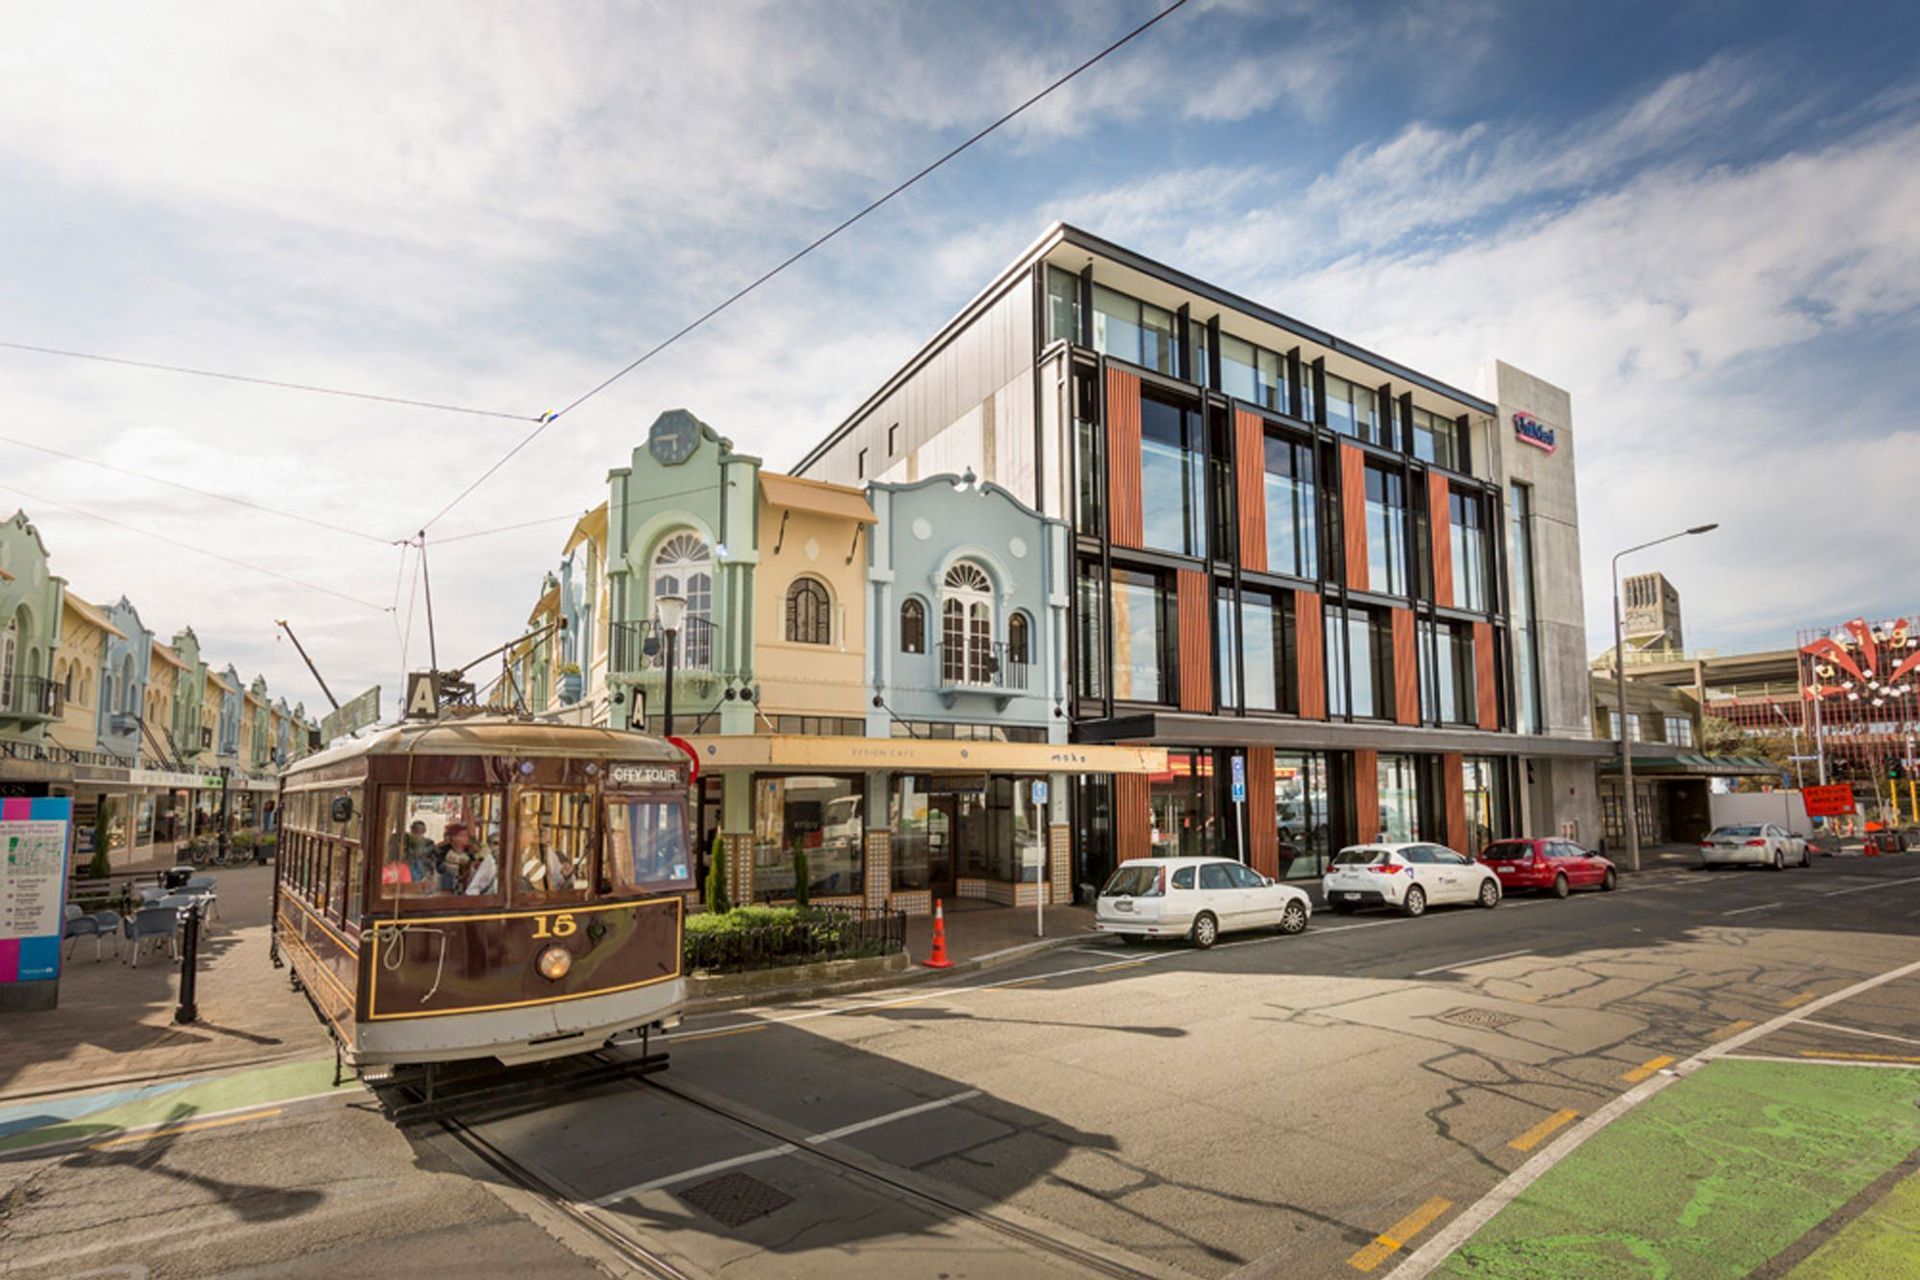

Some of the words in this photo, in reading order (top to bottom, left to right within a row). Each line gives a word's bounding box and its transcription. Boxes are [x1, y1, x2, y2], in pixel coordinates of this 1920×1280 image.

[408, 676, 437, 714] A
[631, 692, 645, 727] A
[613, 766, 643, 782] CITY
[643, 769, 677, 782] TOUR
[531, 913, 578, 939] 15
